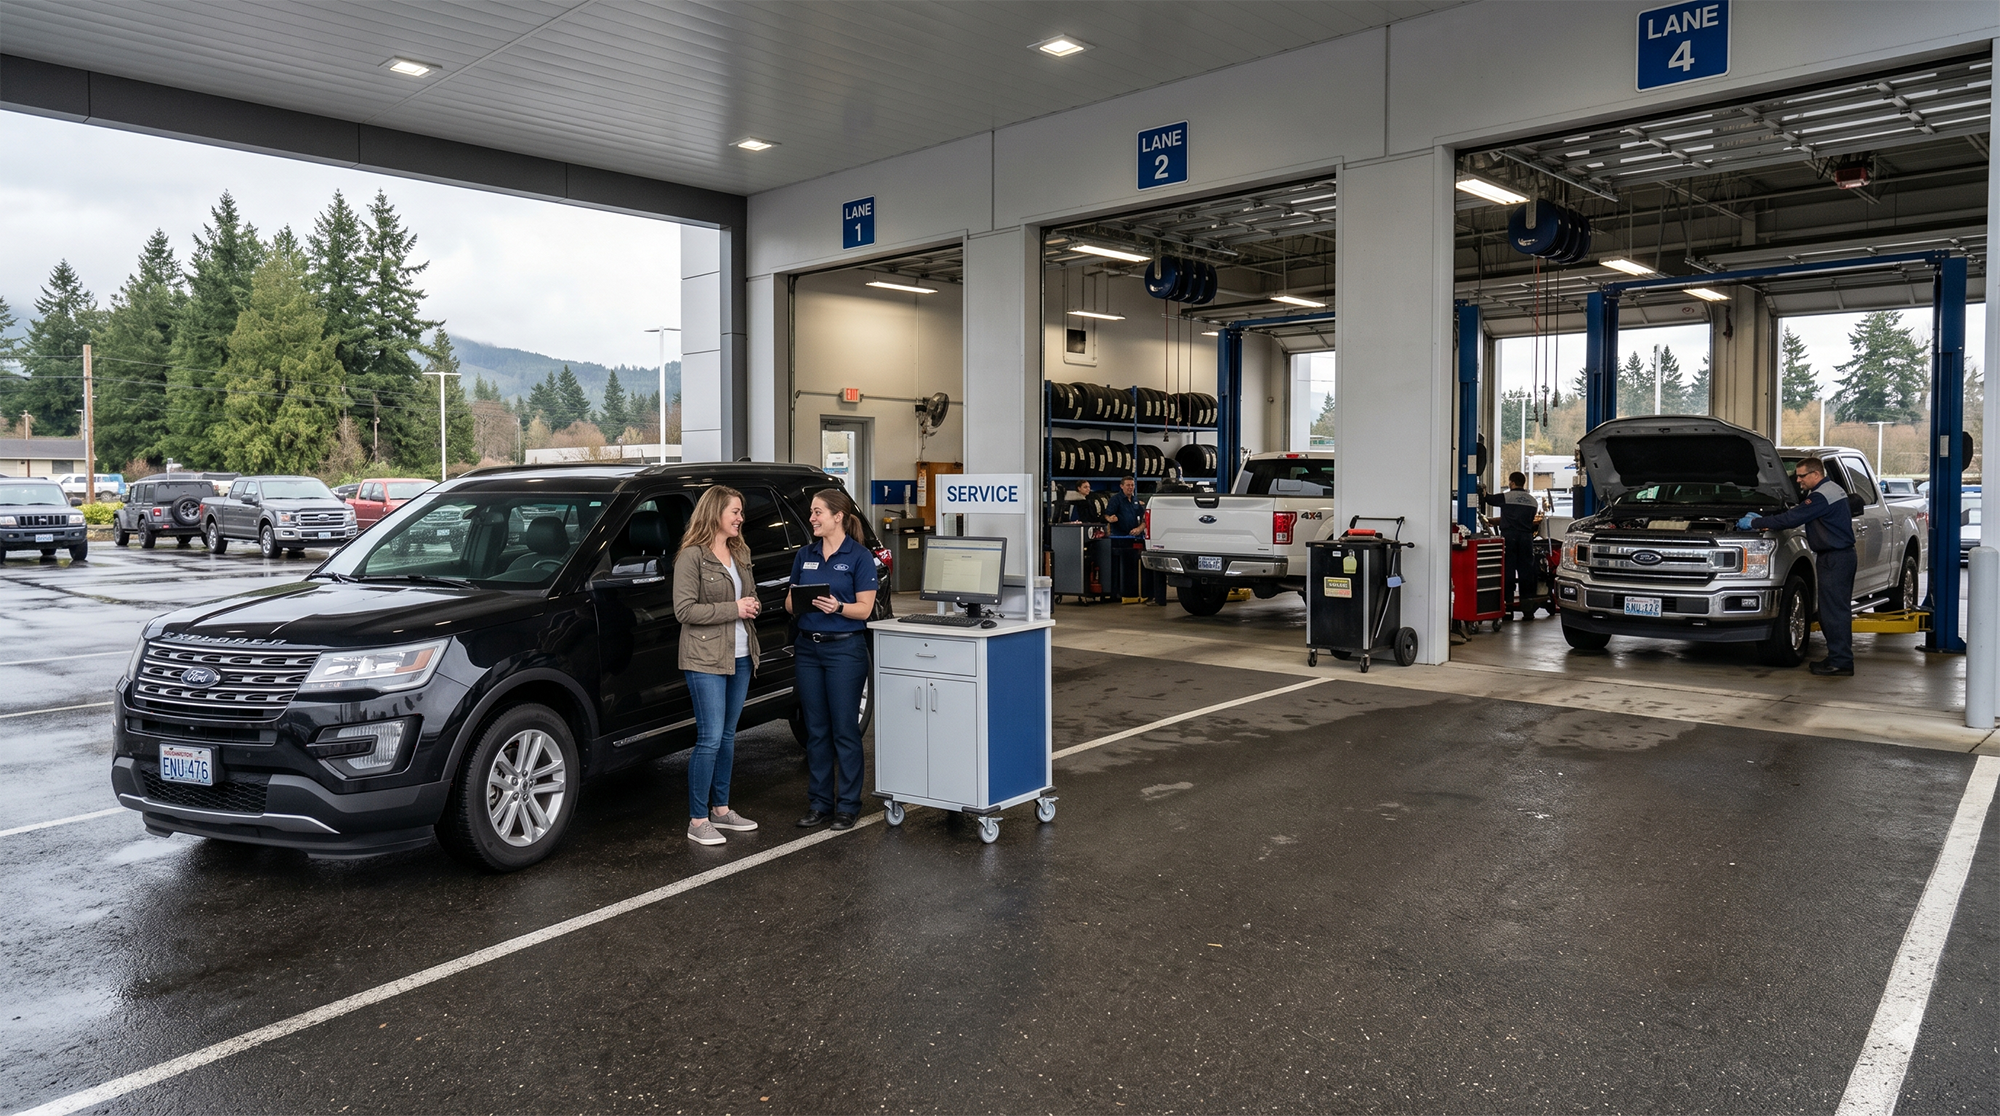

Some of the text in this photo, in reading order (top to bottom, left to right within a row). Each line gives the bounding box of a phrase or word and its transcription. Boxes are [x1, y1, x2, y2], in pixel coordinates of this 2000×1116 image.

[1648, 4, 1719, 40] LANE
[1668, 39, 1695, 72] 4
[1142, 129, 1182, 153] LANE
[1154, 154, 1169, 180] 2
[845, 202, 872, 220] LANE
[854, 222, 861, 242] 1
[947, 485, 1018, 502] SERVICE
[161, 631, 287, 646] EXPLORER
[186, 669, 209, 683] Ford
